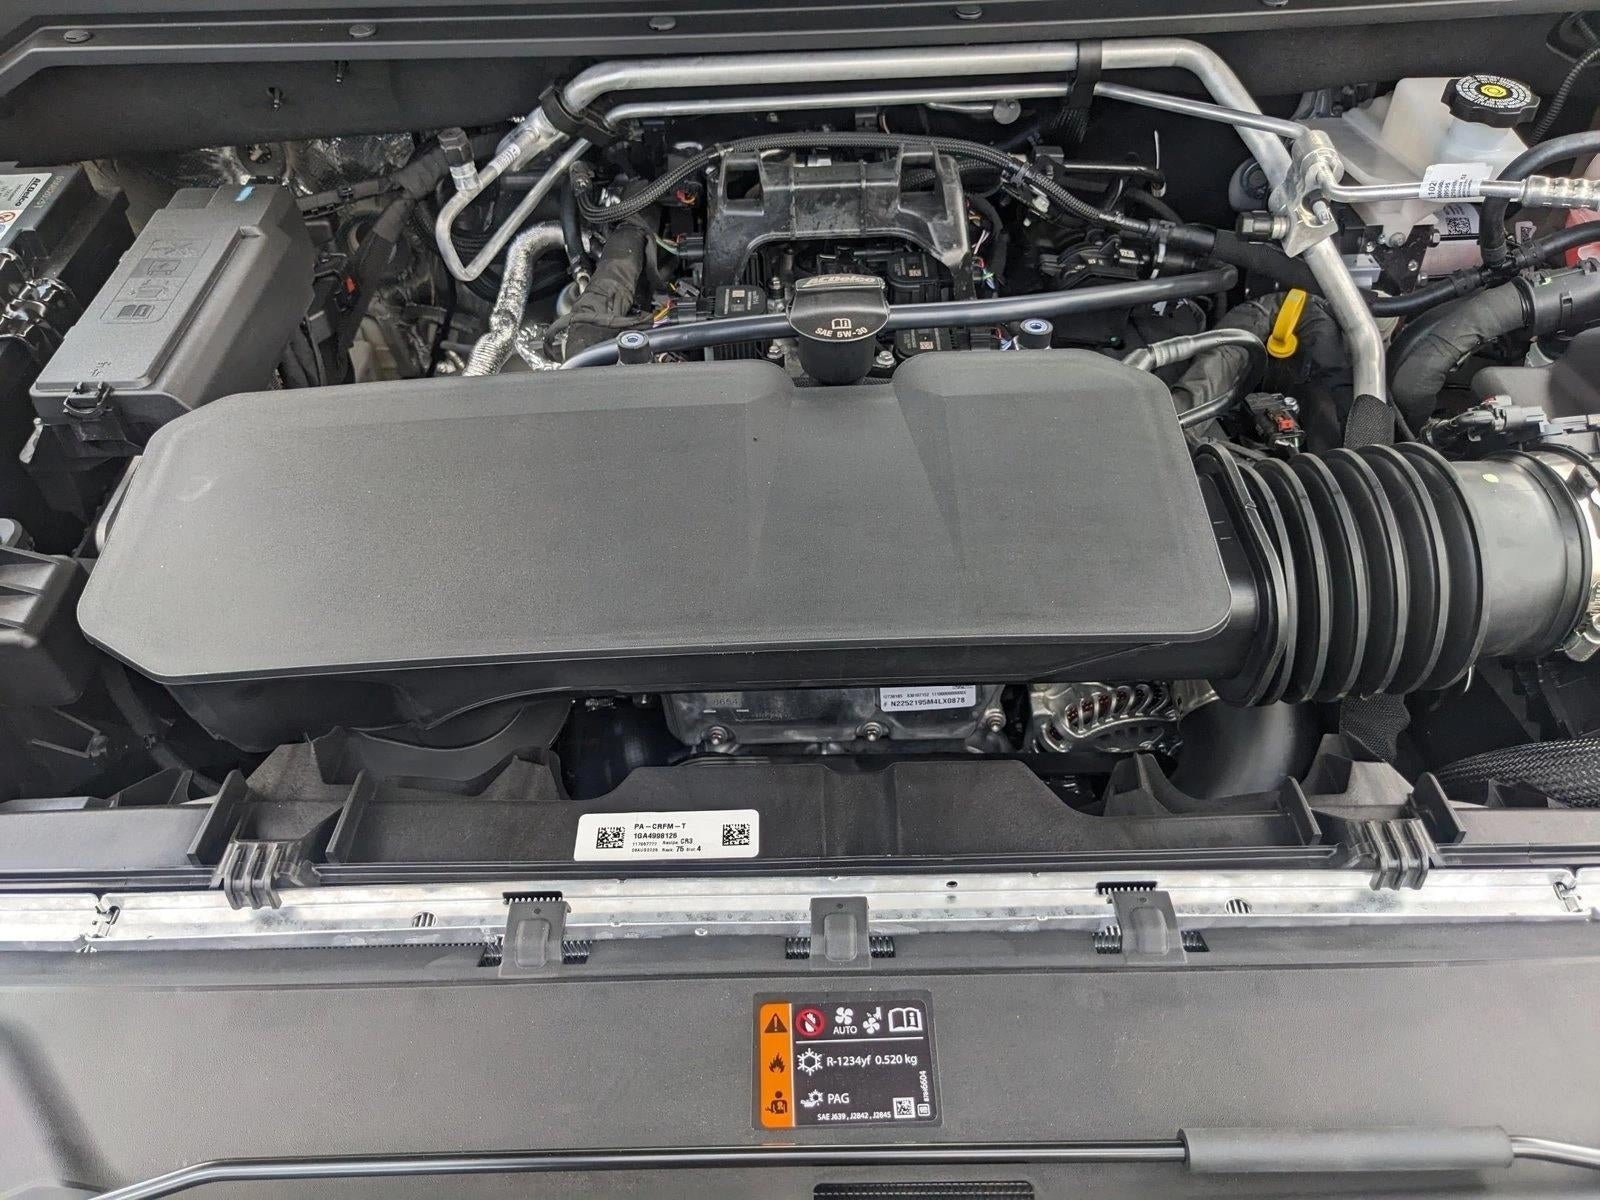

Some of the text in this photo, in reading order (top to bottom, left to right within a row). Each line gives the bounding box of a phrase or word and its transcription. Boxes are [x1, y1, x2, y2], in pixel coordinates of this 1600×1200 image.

[815, 326, 868, 338] SAE 5W-30
[833, 1025, 857, 1035] AUTO
[826, 1053, 918, 1067] R-1234yf 0.520 kg
[827, 1093, 850, 1104] PAG
[817, 1113, 830, 1121] SAE
